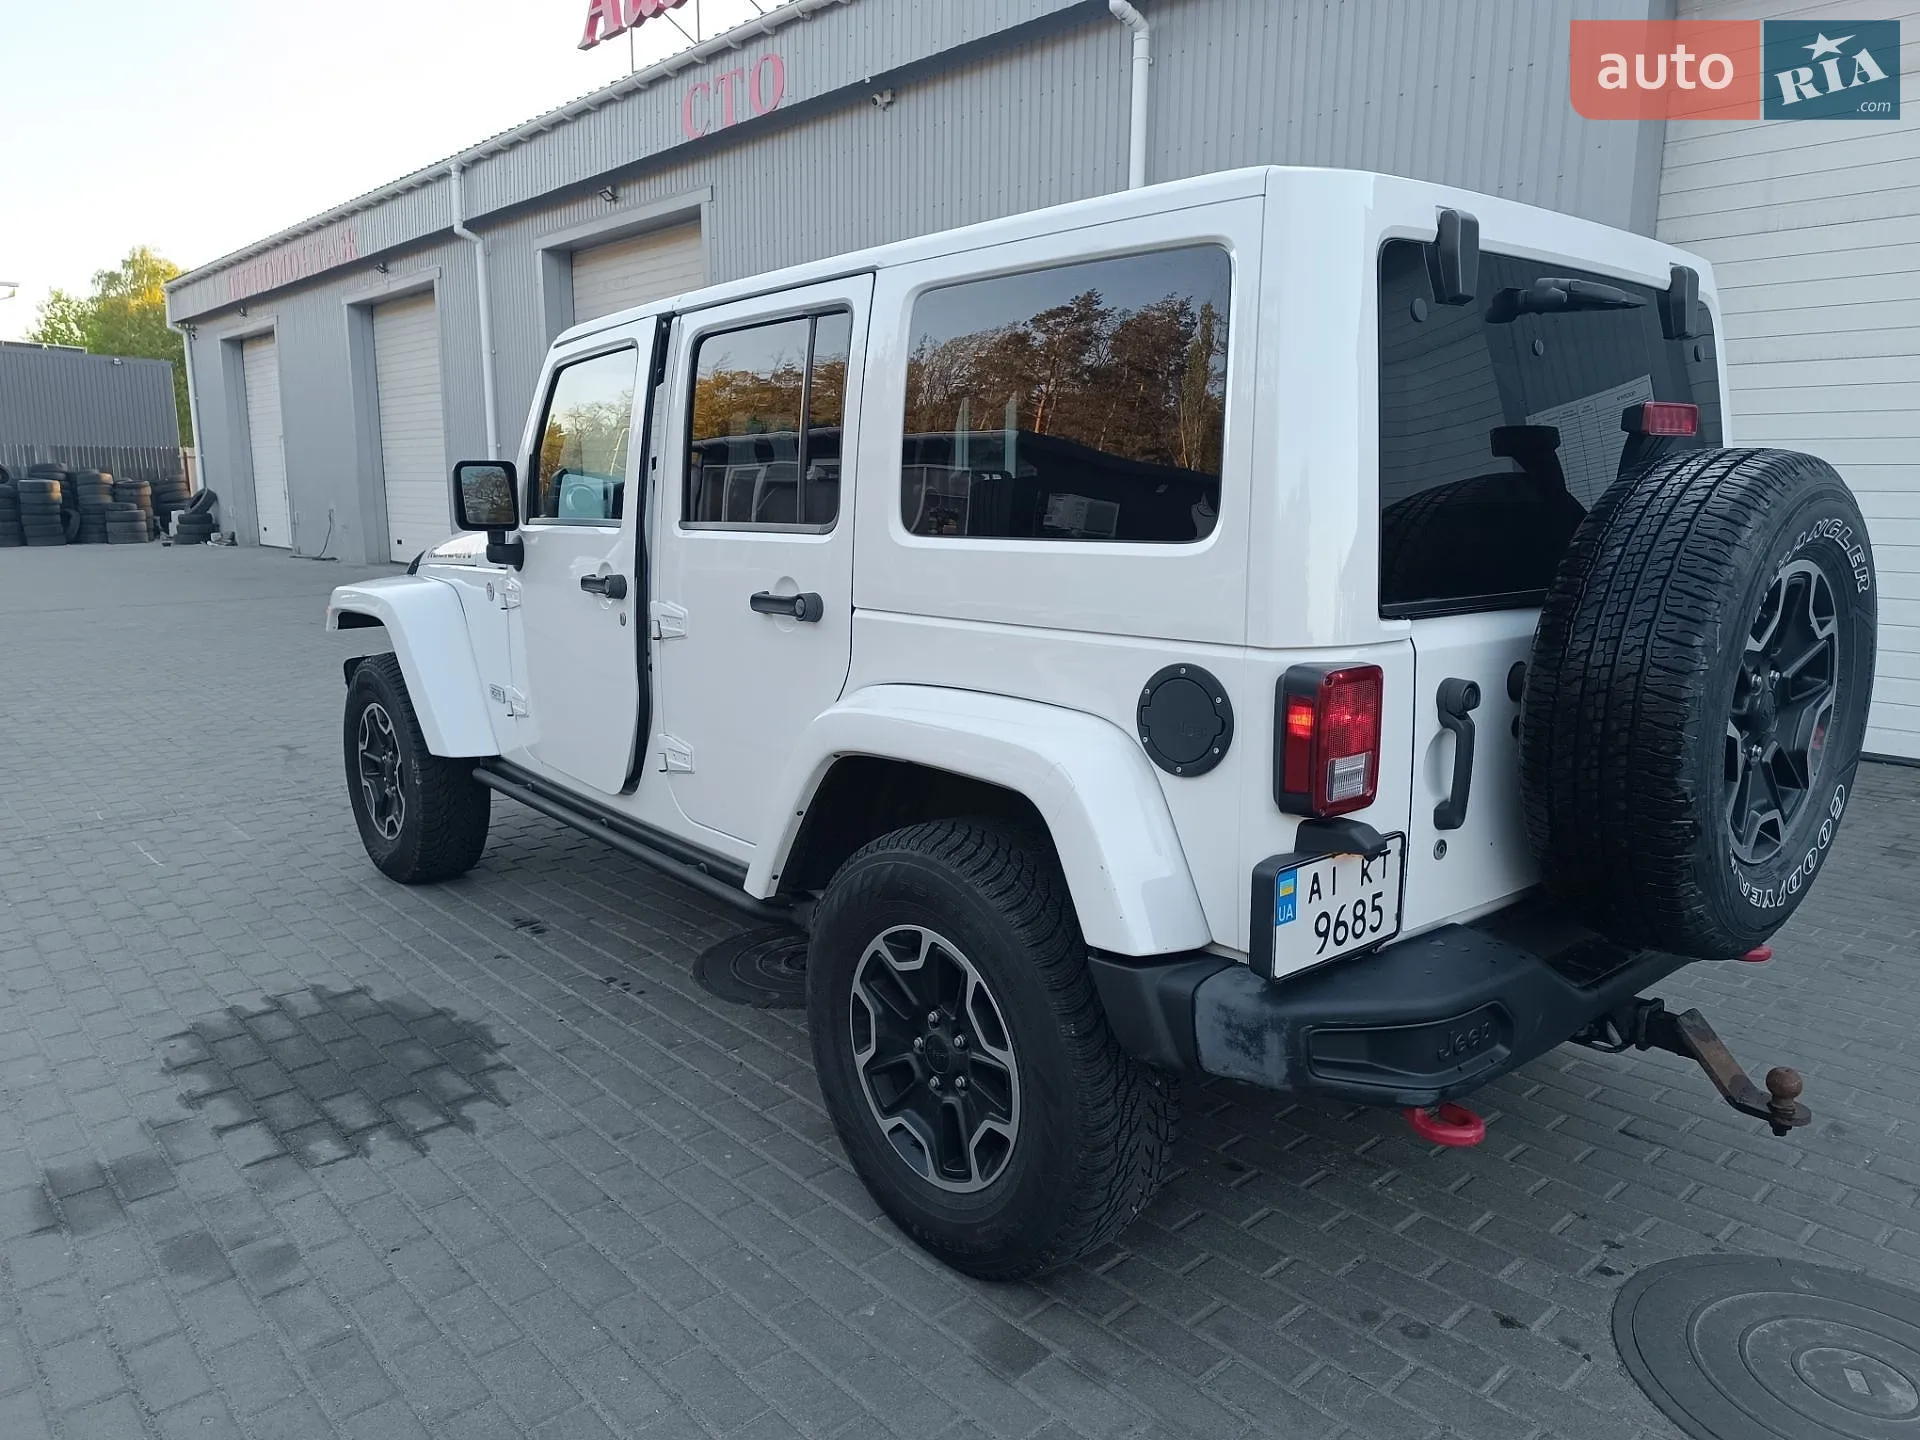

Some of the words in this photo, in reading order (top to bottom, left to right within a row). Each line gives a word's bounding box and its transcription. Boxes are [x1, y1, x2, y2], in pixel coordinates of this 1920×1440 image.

[682, 53, 785, 140] СТО
[1278, 903, 1294, 922] UA
[1314, 891, 1384, 955] 9685
[1437, 1021, 1489, 1061] Jeep
